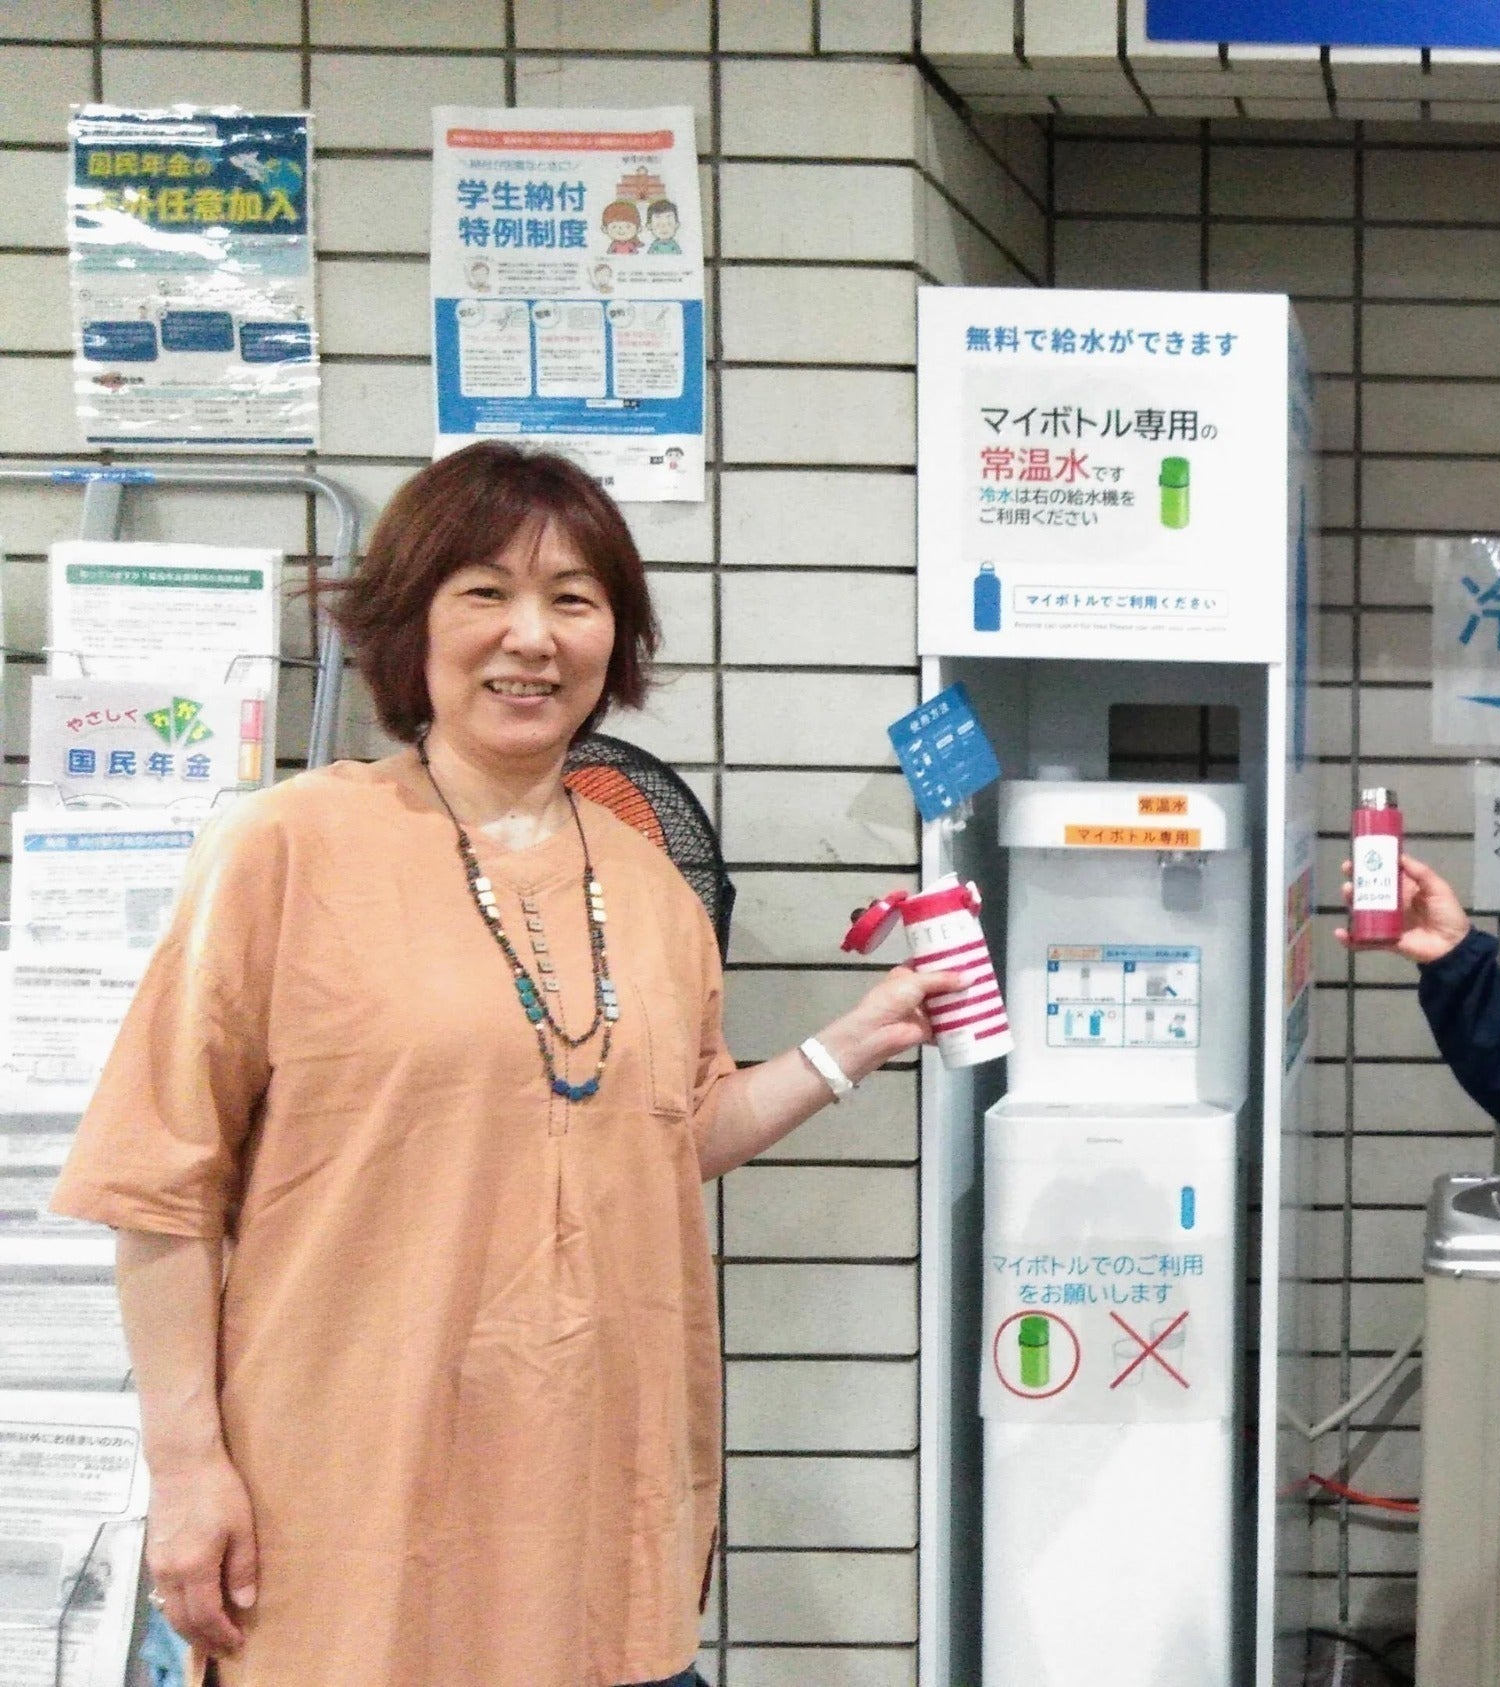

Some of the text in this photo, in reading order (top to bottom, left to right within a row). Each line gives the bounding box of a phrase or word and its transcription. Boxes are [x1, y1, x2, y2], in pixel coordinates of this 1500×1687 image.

[88, 152, 214, 178] 国民年金の
[86, 187, 297, 223] 外任意加入
[457, 179, 587, 212] 学生納付
[458, 217, 588, 249] 特例制度
[966, 326, 1238, 356] 無料で給水ができます
[980, 408, 1218, 441] マイボトル専用の
[980, 446, 1125, 484] 常温水です
[979, 487, 1136, 508] 冷水は右の給水機を
[979, 508, 1098, 526] ご利用ください
[1026, 593, 1217, 610] マイボトルでご利用ください
[66, 708, 139, 734] やさしく
[67, 747, 212, 778] 国民年金
[1140, 797, 1188, 814] 常温水
[1078, 828, 1190, 847] マイボトル専用
[991, 1254, 1204, 1277] マイボトルでのご利用
[1019, 1283, 1173, 1305] をお願いします
